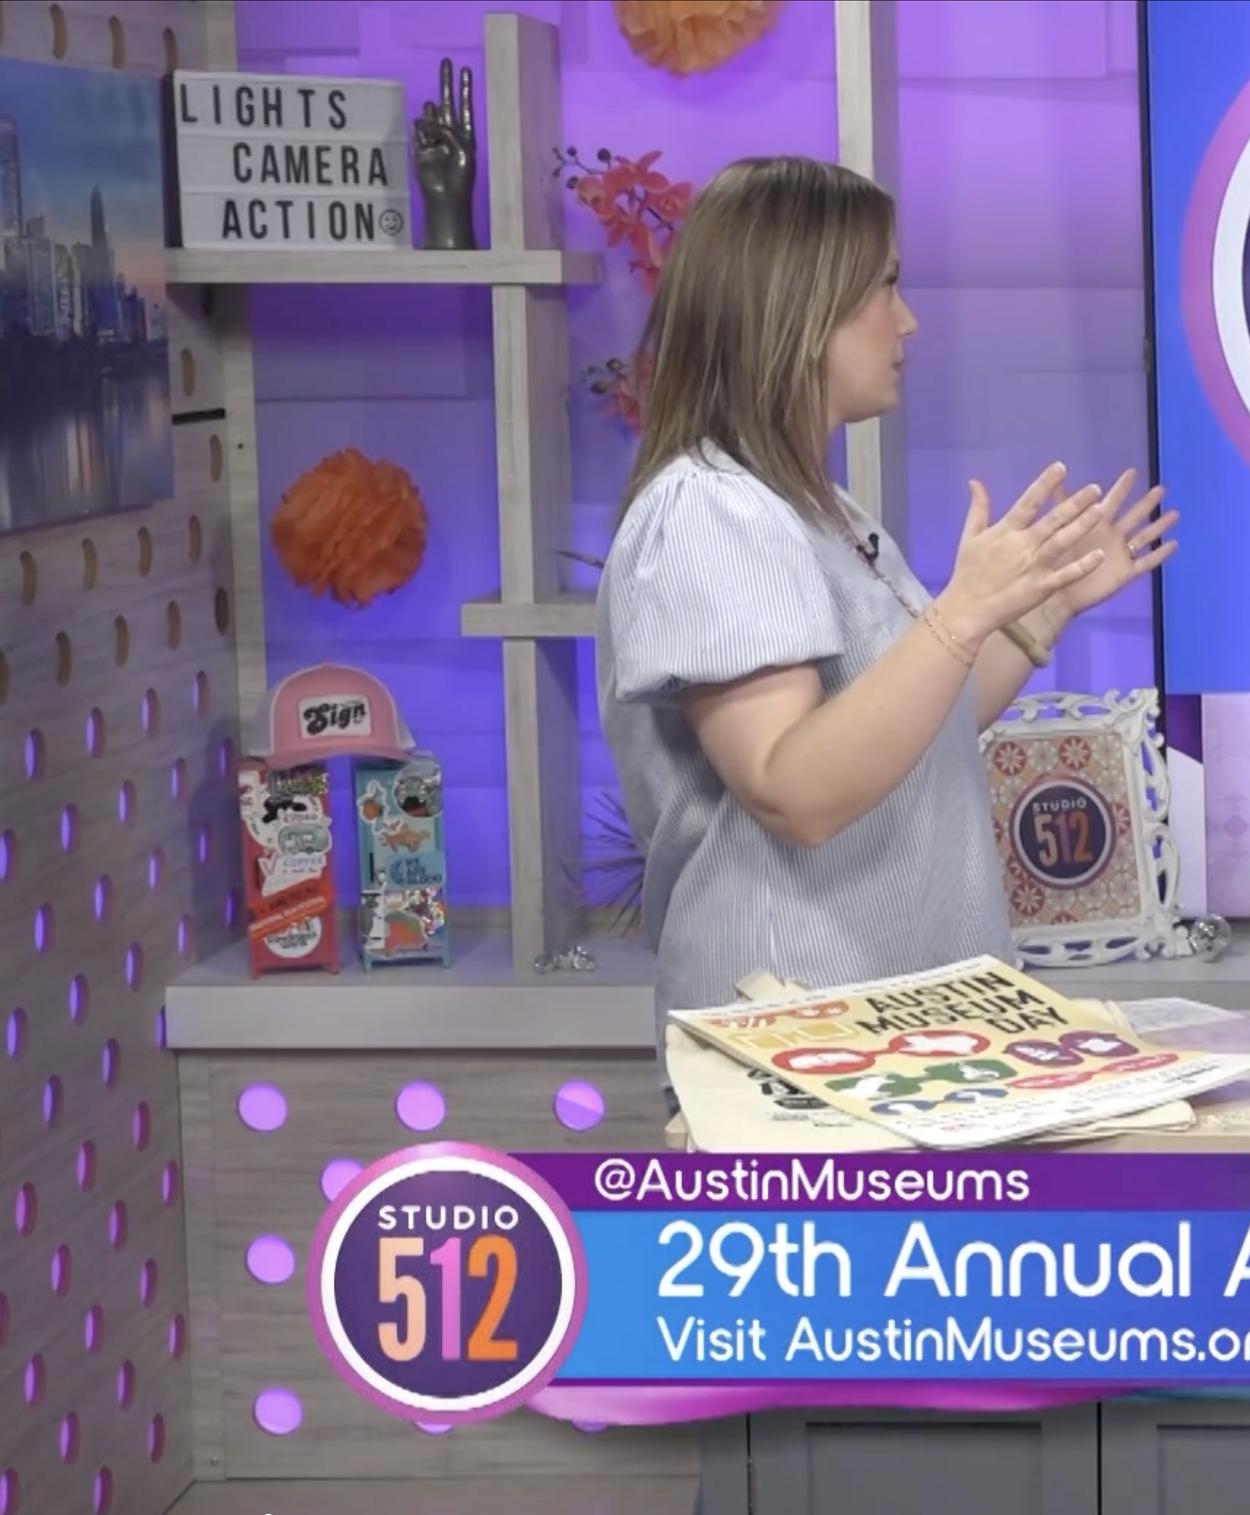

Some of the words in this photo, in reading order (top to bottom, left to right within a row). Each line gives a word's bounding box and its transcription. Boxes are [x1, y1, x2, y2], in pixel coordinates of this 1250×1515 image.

[180, 83, 347, 130] LIGHTS
[233, 141, 388, 187] CAMERA
[221, 198, 375, 241] ACTION
[303, 702, 367, 735] Sign
[1033, 798, 1087, 811] STUDIO
[1034, 812, 1093, 867] 512
[855, 989, 1046, 1035] MUSEUM
[865, 971, 1015, 1013] AUSTIN
[986, 1006, 1070, 1034] DAY
